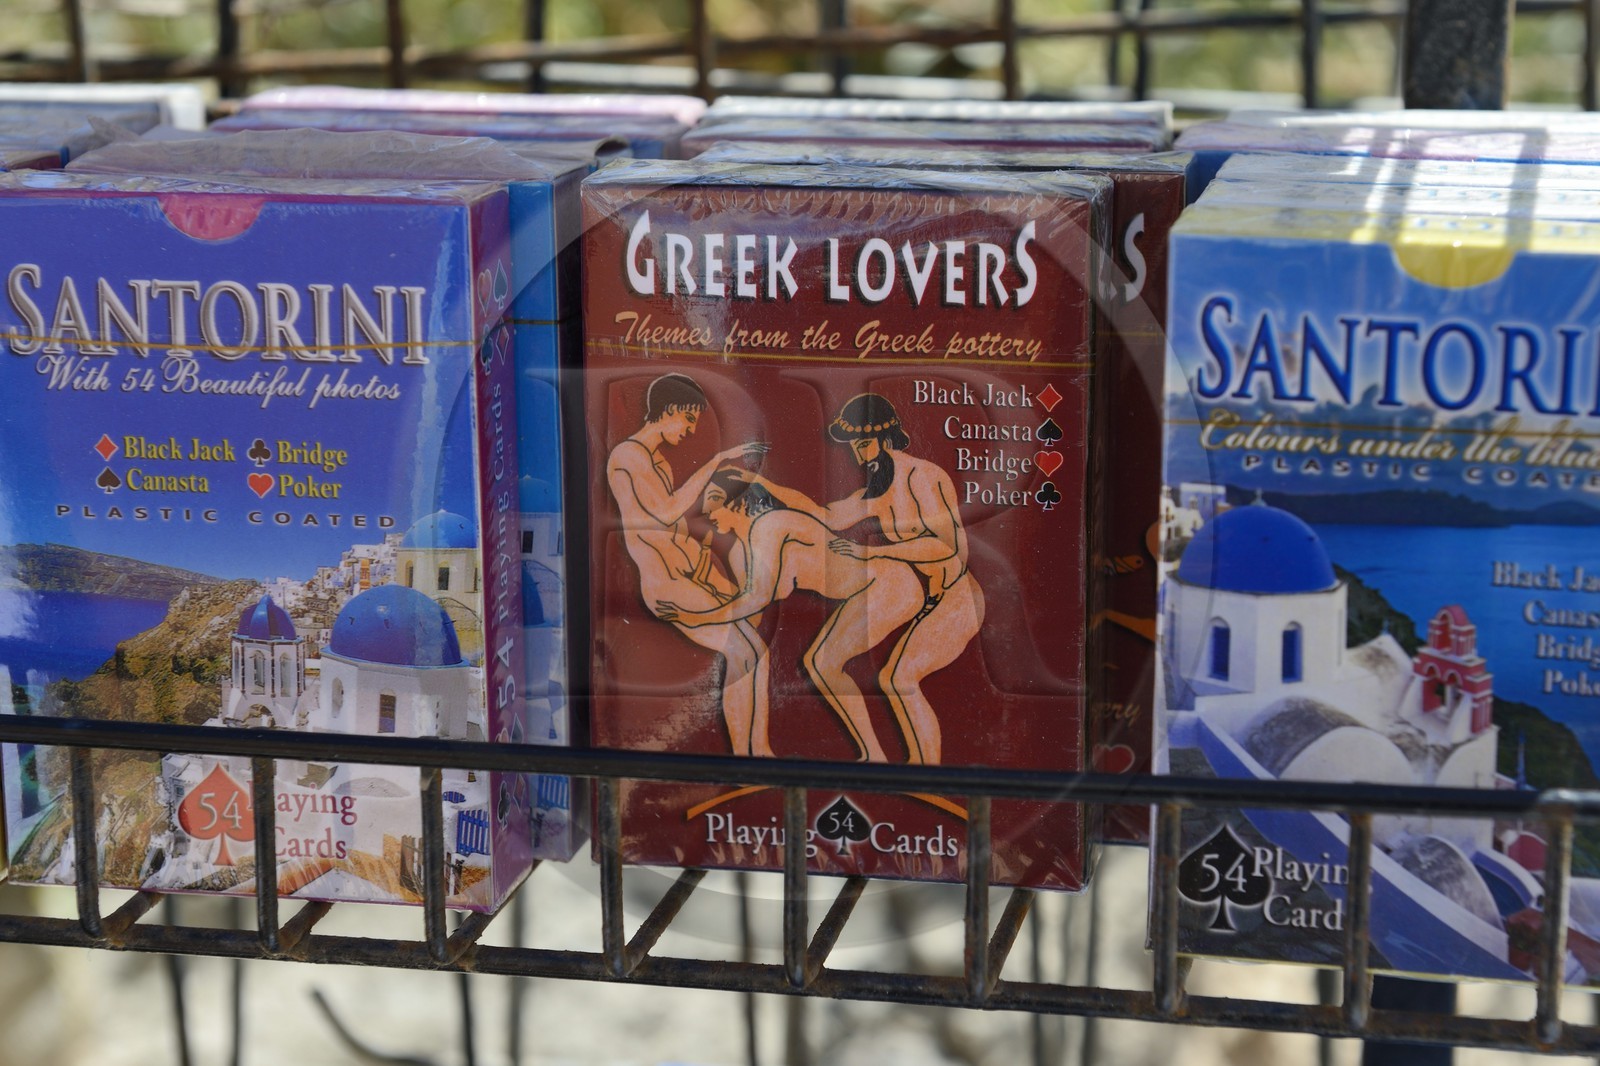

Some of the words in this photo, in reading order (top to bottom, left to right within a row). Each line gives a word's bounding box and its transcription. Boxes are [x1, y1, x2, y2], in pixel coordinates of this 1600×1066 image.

[627, 209, 799, 299] GREEK
[828, 220, 1037, 306] LOVERS
[8, 263, 430, 365] SANTORINI
[615, 311, 712, 346] Themes
[724, 318, 790, 353] from
[802, 321, 841, 349] the
[855, 320, 935, 358] Greek
[943, 327, 1043, 362] pottery
[37, 355, 111, 392] With
[121, 368, 155, 392] 54
[161, 357, 313, 408] Beautiful
[309, 369, 401, 408] photos
[914, 380, 975, 405] Black
[982, 385, 1033, 411] Jack
[491, 383, 505, 481] Cards
[944, 415, 1032, 441] Canasta
[1201, 409, 1341, 454] Colours
[1349, 427, 1457, 462] under
[1463, 415, 1521, 464] the
[123, 435, 183, 460] Black
[189, 439, 237, 462] Jack
[277, 441, 349, 472] Bridge
[957, 448, 1033, 480] Bridge
[1244, 455, 1431, 479] PLASTIC
[126, 469, 209, 494] Canasta
[279, 475, 342, 498] Poker
[965, 480, 1032, 507] Poker
[57, 505, 218, 522] PLASTIC
[249, 511, 396, 528] COATED
[497, 491, 510, 622] Playing
[1492, 560, 1561, 589] Black
[497, 635, 516, 711] 54
[199, 790, 244, 831] 54
[247, 780, 357, 826] aying
[705, 813, 818, 858] Playig
[828, 812, 854, 833] 54
[870, 823, 958, 858] Cards
[1201, 853, 1247, 894] 54
[1251, 847, 1373, 891] Playin
[1263, 895, 1344, 932] Card
